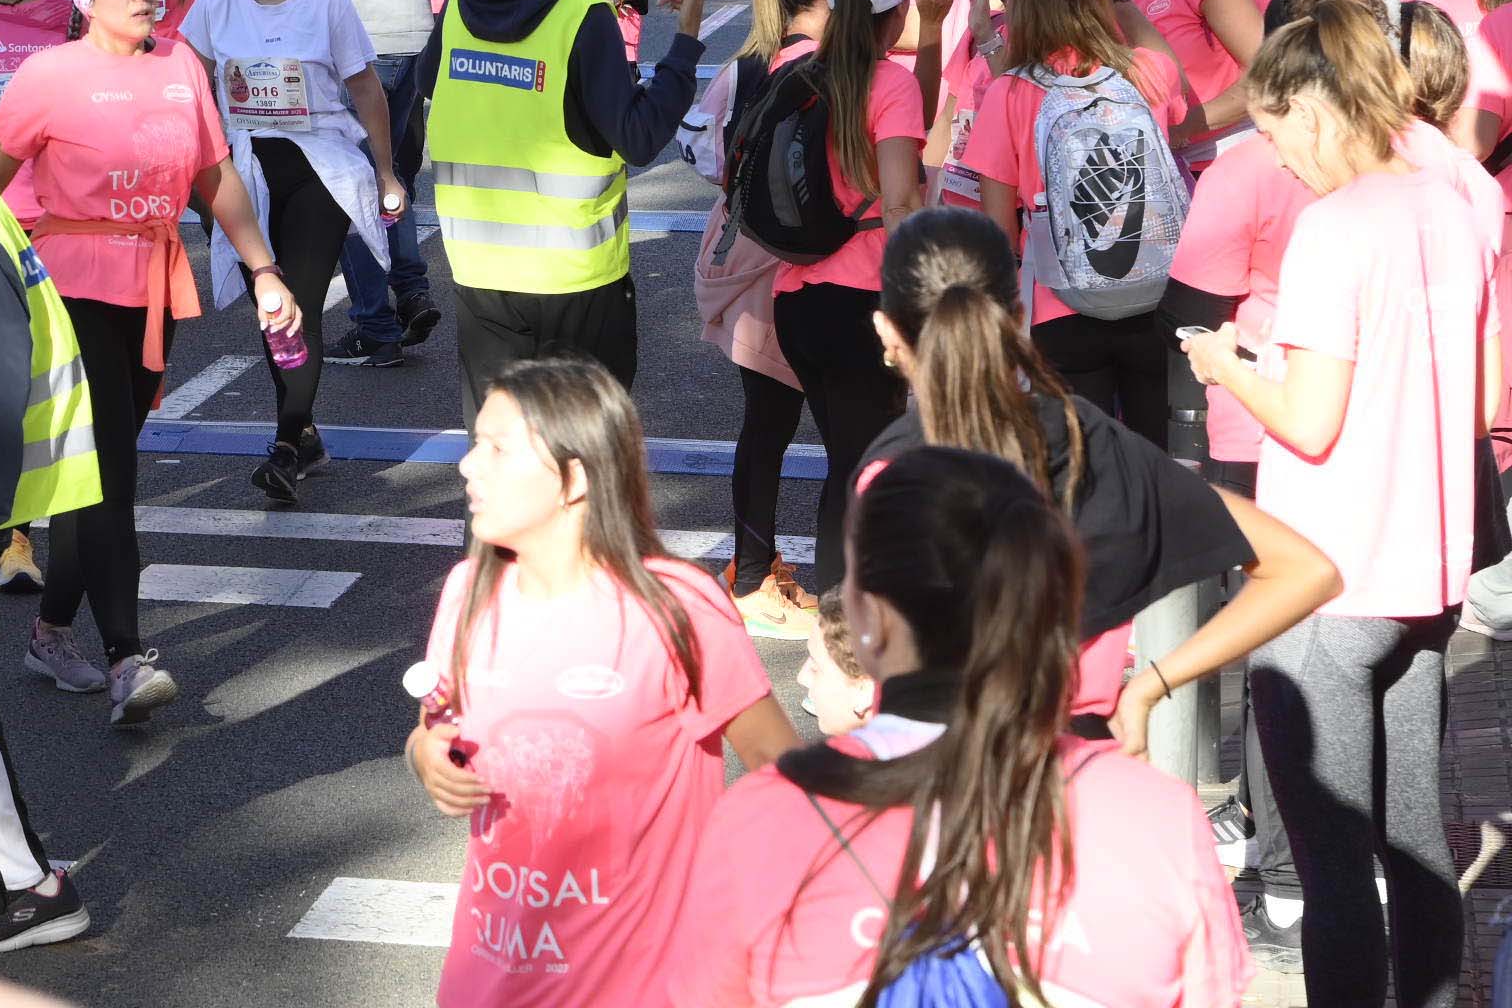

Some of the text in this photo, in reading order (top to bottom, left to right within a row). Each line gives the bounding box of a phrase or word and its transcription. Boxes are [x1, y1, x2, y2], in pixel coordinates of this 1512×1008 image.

[8, 42, 55, 54] Santand
[451, 56, 534, 84] VOLUNTARIS
[251, 86, 279, 98] 016
[256, 100, 277, 108] 13897
[109, 168, 140, 191] TU
[110, 195, 175, 220] DORS
